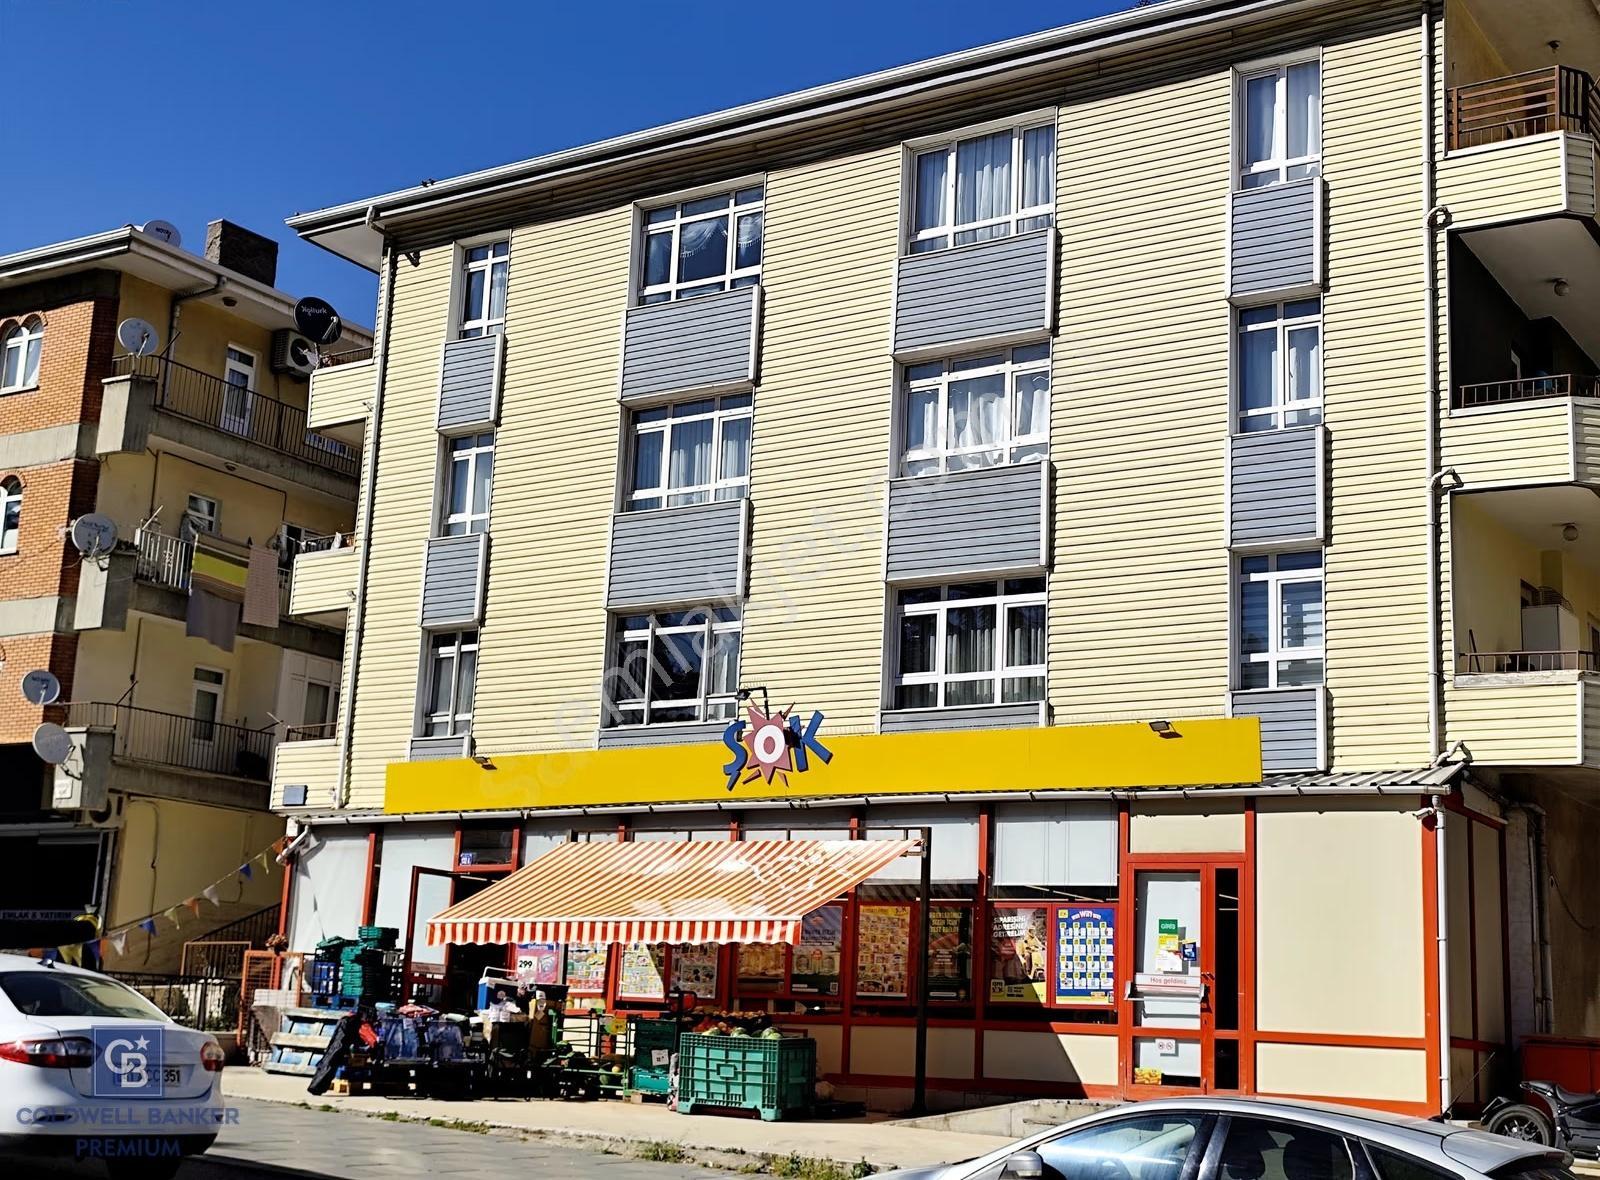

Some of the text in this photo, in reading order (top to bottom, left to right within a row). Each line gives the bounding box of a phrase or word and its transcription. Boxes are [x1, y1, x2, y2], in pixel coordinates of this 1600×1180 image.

[723, 710, 833, 790] ŞOK
[518, 959, 533, 968] 299
[163, 1069, 180, 1083] 351
